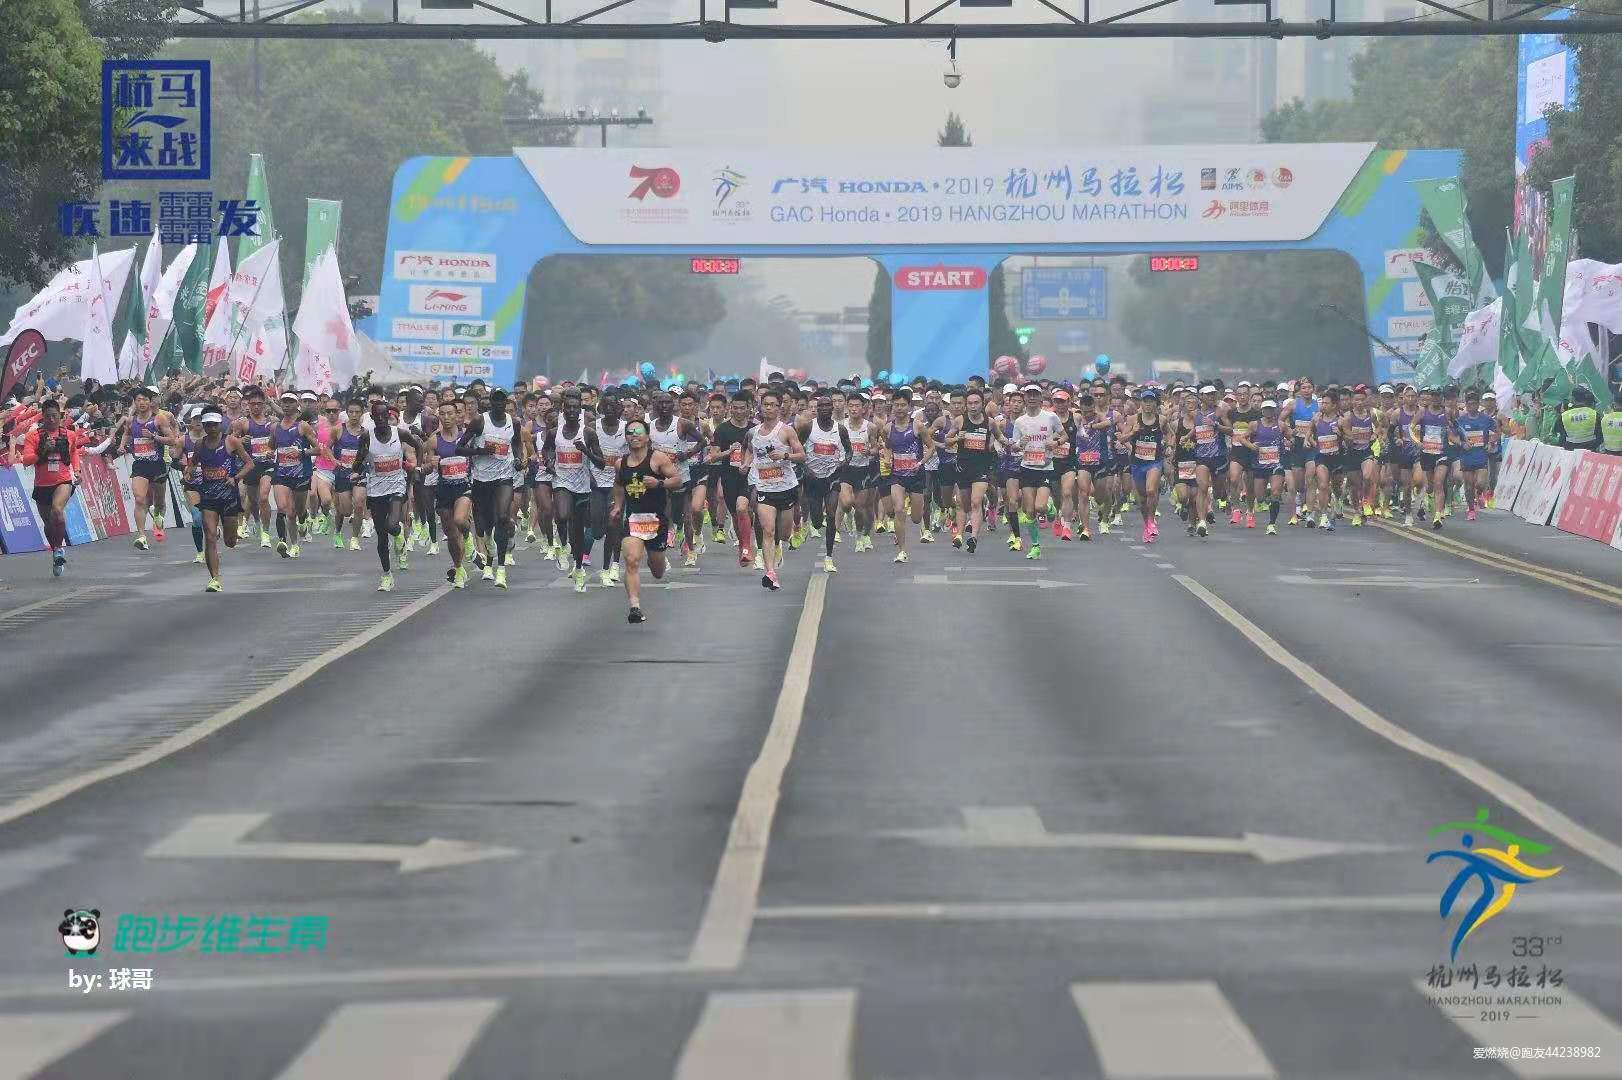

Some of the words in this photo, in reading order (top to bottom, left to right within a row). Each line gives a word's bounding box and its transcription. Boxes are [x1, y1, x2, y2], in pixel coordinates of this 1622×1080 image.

[771, 177, 828, 194] 广汽
[838, 181, 928, 193] HONDA
[944, 177, 994, 195] 2019
[1003, 164, 1185, 200] 杭州马拉松
[770, 205, 814, 222] GAC
[820, 205, 880, 222] Honda
[897, 205, 943, 222] 2019
[949, 203, 1065, 222] HANGZHOU
[1073, 203, 1187, 221] MARATHON
[439, 259, 491, 268] HONDA
[907, 271, 974, 286] START
[424, 303, 468, 312] LI-NING
[451, 347, 472, 355] KFC
[11, 342, 38, 377] KFC
